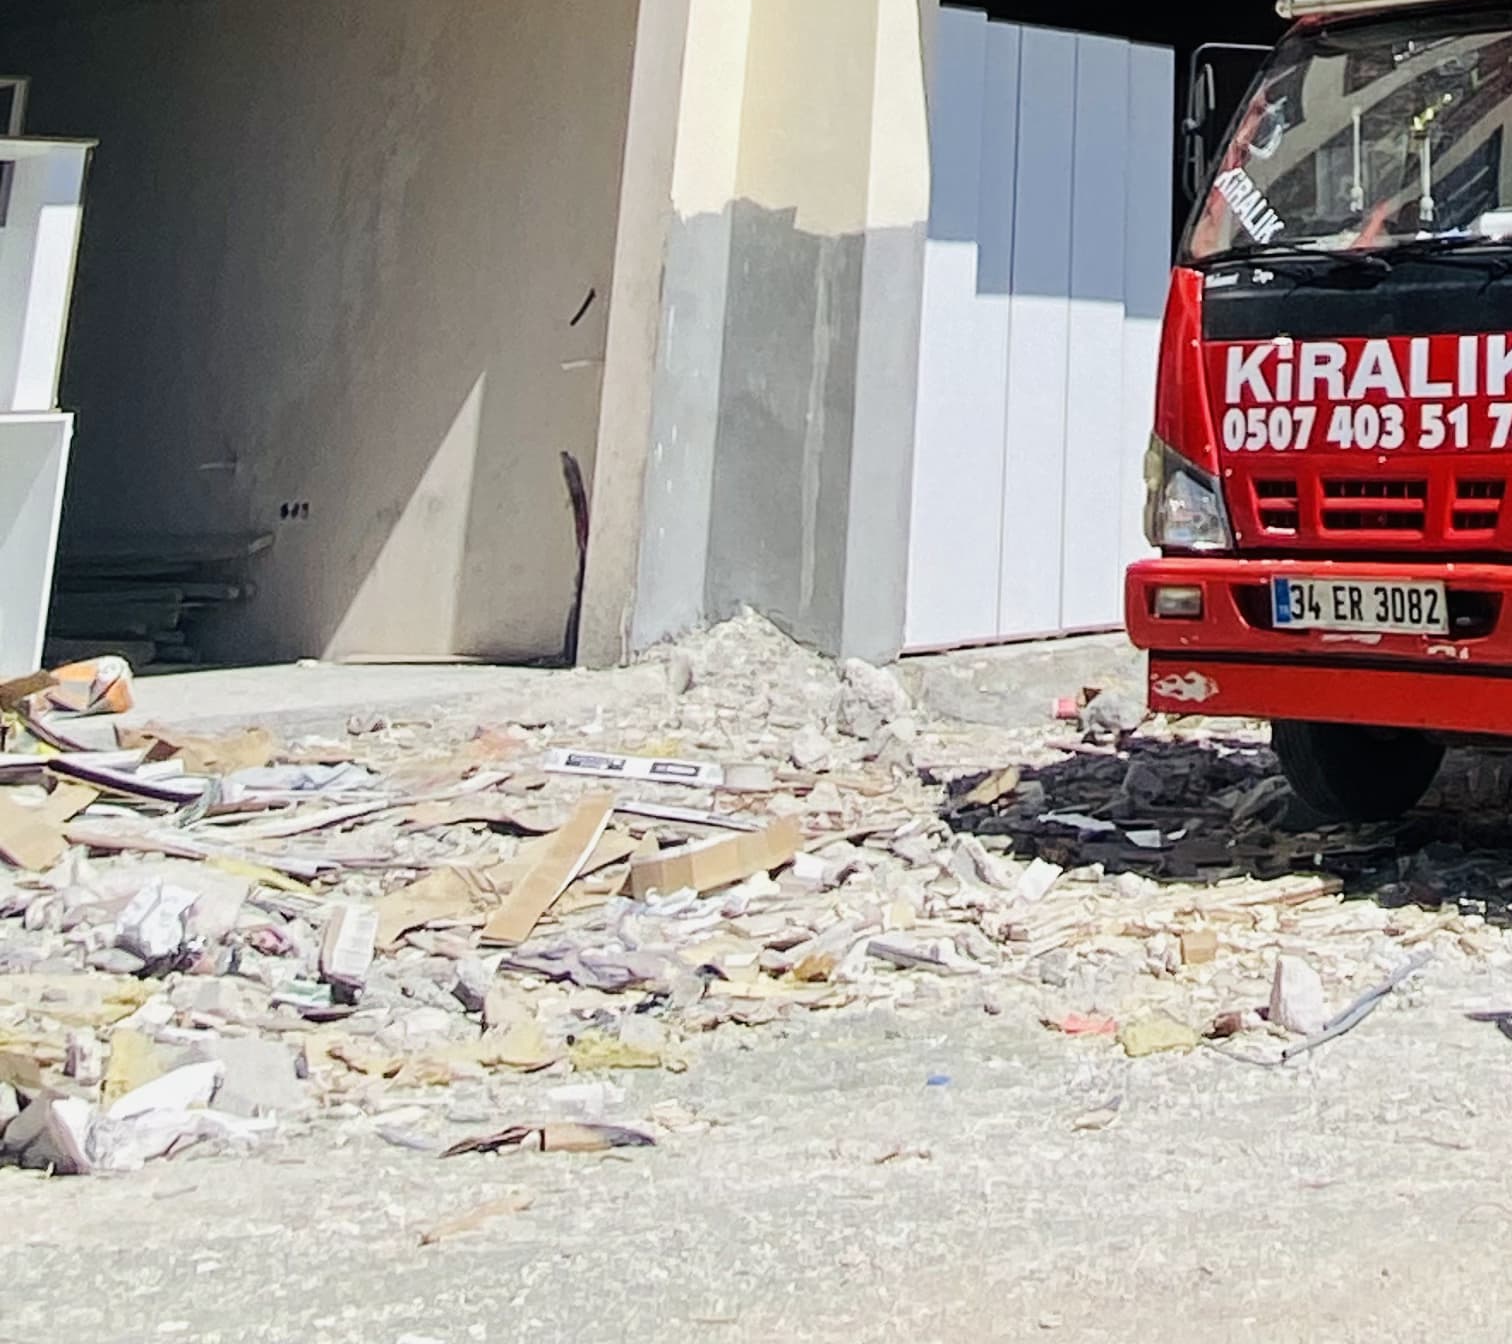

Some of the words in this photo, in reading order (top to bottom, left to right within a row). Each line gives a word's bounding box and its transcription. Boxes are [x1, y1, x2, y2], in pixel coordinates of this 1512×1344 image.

[1222, 405, 1317, 453] 0507
[1326, 403, 1405, 450] 403
[1418, 402, 1469, 450] 51
[1290, 583, 1321, 621] 34
[1332, 585, 1364, 622] ER
[1374, 586, 1441, 625] 3082
